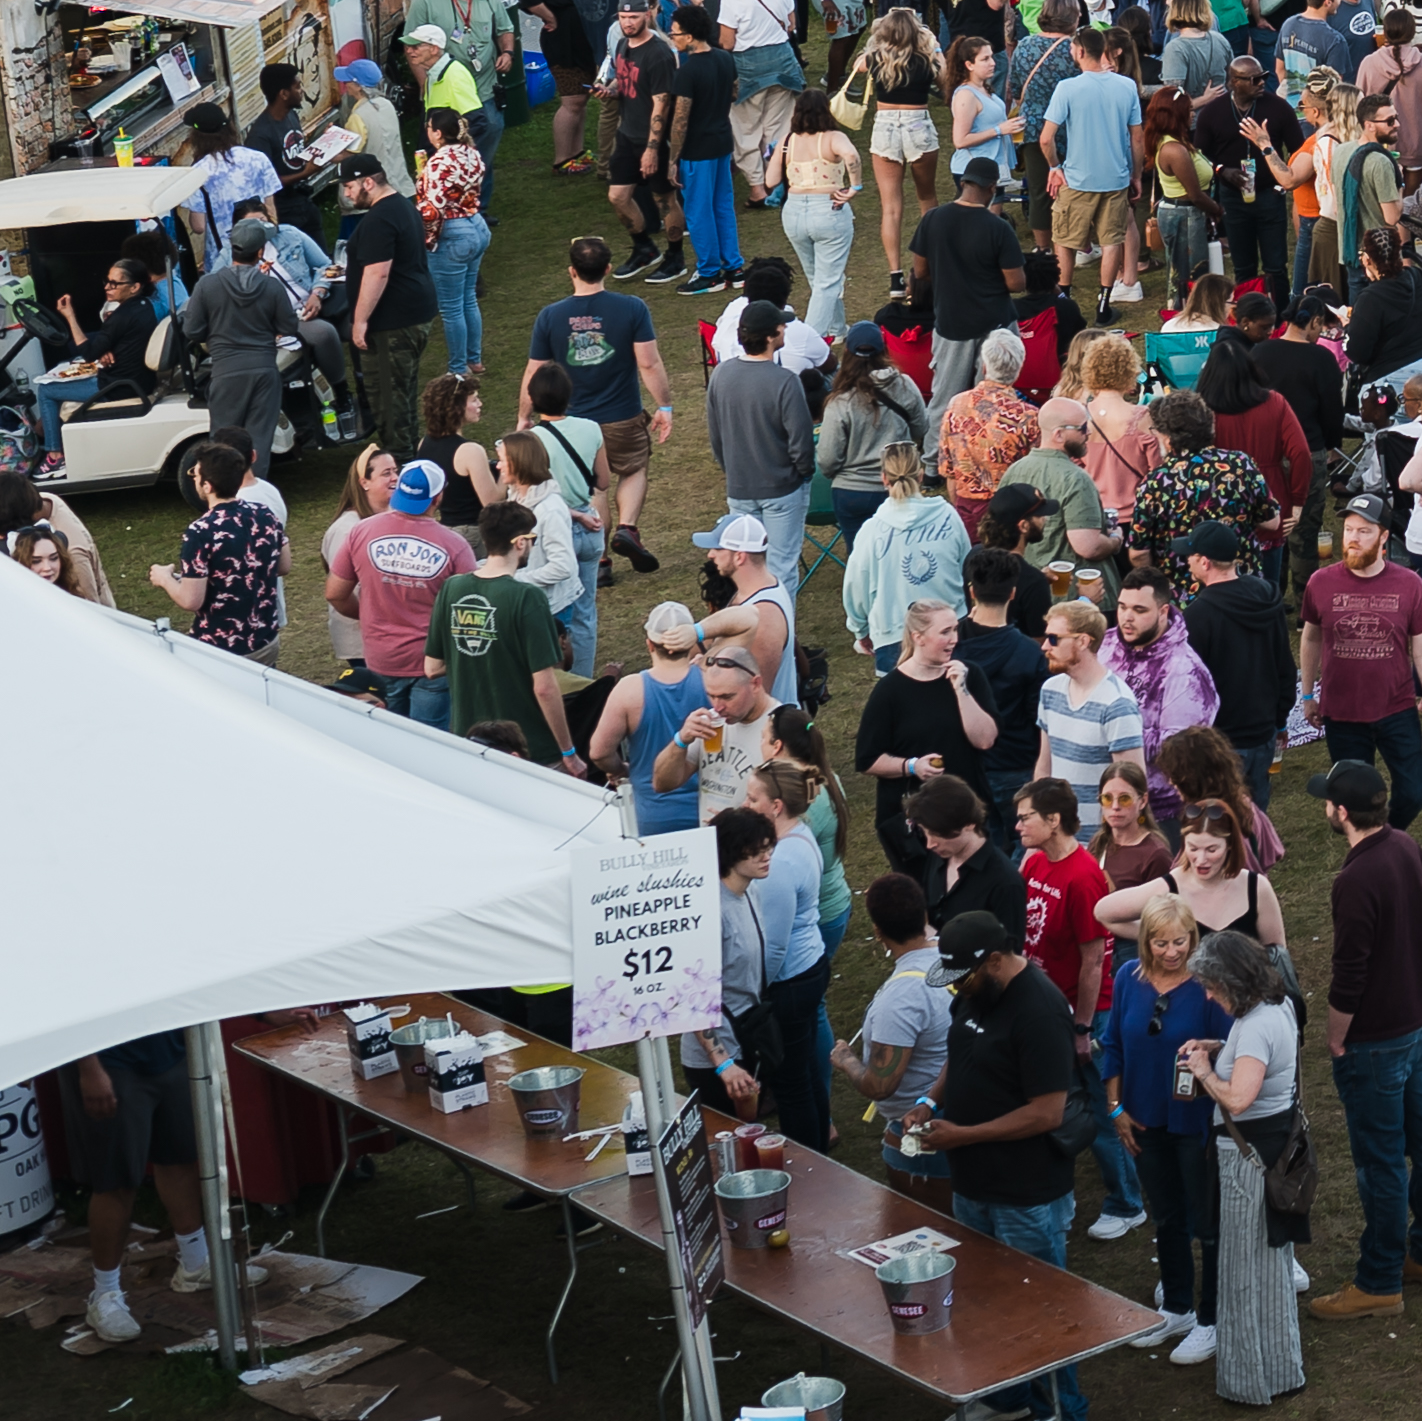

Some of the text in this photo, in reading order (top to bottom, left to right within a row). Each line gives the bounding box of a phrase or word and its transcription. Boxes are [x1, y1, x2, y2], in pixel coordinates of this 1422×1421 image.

[376, 541, 443, 565] RON JON
[381, 558, 432, 574] SURFBOARDS
[701, 746, 755, 780] SEATTLE
[600, 846, 689, 873] BULLY HILL
[591, 869, 705, 906] wine slushies
[604, 893, 692, 922] PINEAPPLE
[594, 915, 703, 946] BLACKBERRY
[622, 946, 674, 981] $12
[633, 982, 667, 996] 16 OZ.
[891, 1305, 924, 1317] GENESEE
